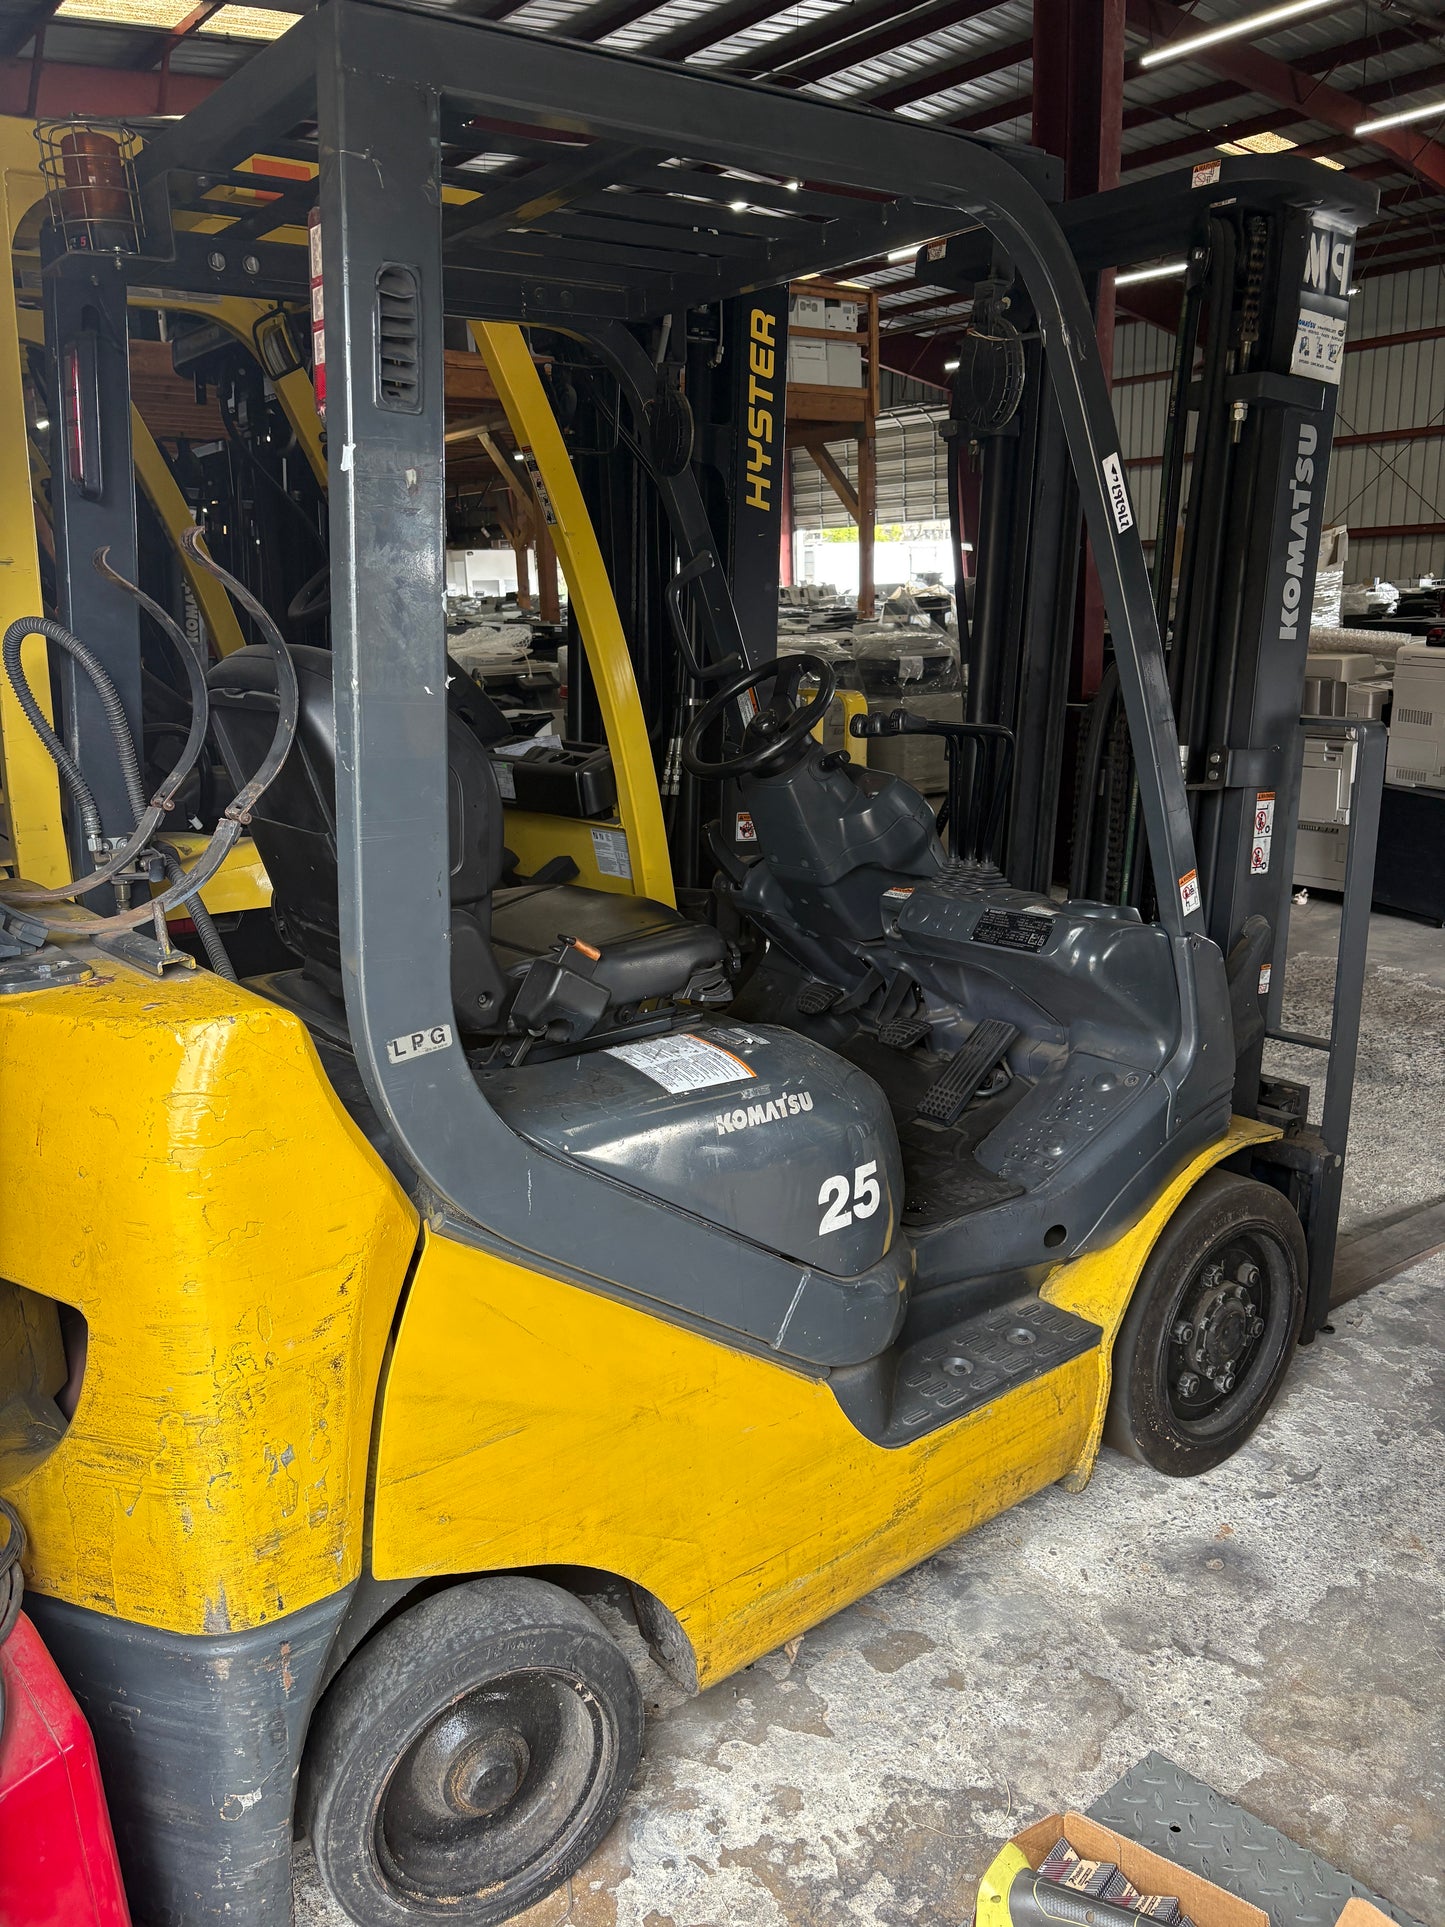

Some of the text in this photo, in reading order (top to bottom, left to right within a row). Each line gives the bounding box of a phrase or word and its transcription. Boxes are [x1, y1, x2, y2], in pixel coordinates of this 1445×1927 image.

[746, 308, 775, 512] HYSTER
[1279, 423, 1317, 640] KOMATSU
[715, 1091, 814, 1136] KOMATSU
[818, 1160, 881, 1237] 25
